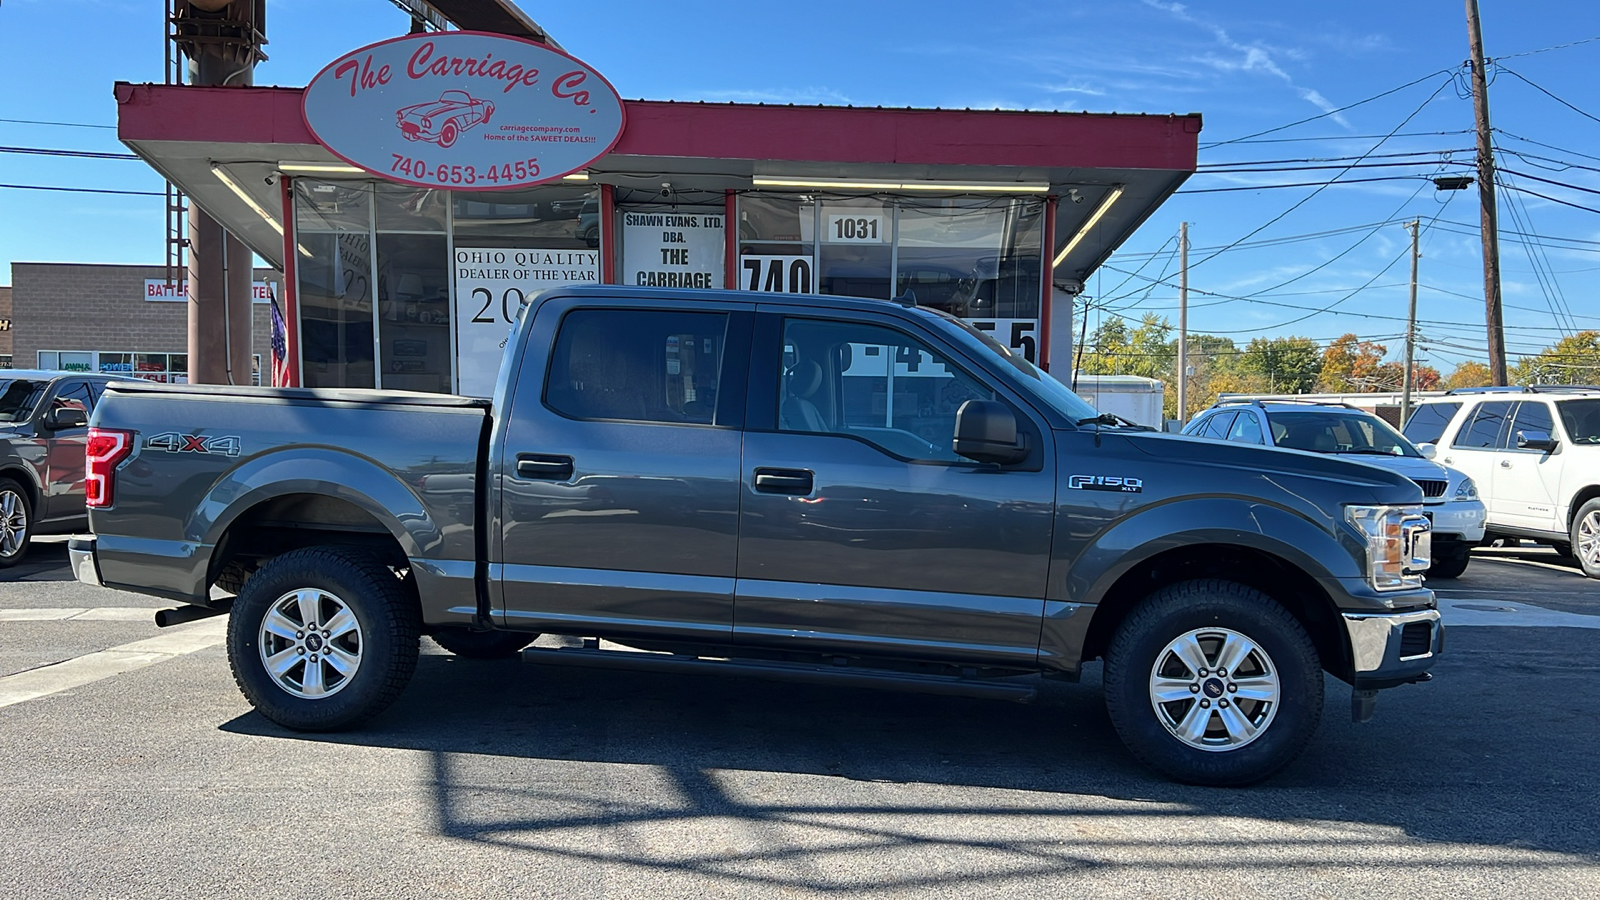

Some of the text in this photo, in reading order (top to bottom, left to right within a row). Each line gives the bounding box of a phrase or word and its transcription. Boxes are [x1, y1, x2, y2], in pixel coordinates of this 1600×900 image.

[335, 41, 597, 114] The Carriage Co.
[499, 124, 581, 134] carriagecompany.com
[483, 133, 506, 141] Home
[507, 133, 515, 141] of
[516, 134, 529, 142] the
[564, 135, 596, 143] DEALS!!!
[391, 153, 541, 185] 740-653-4455
[625, 214, 724, 229] SHAWN EVANS. LTD.
[834, 218, 878, 239] 1031
[662, 231, 687, 244] DBA.
[457, 251, 598, 267] OHIO QUALITY
[660, 248, 689, 265] THE
[459, 268, 596, 281] DEALER OF THE YEAR
[636, 270, 712, 289] CARRIAGE
[743, 258, 811, 294] 740
